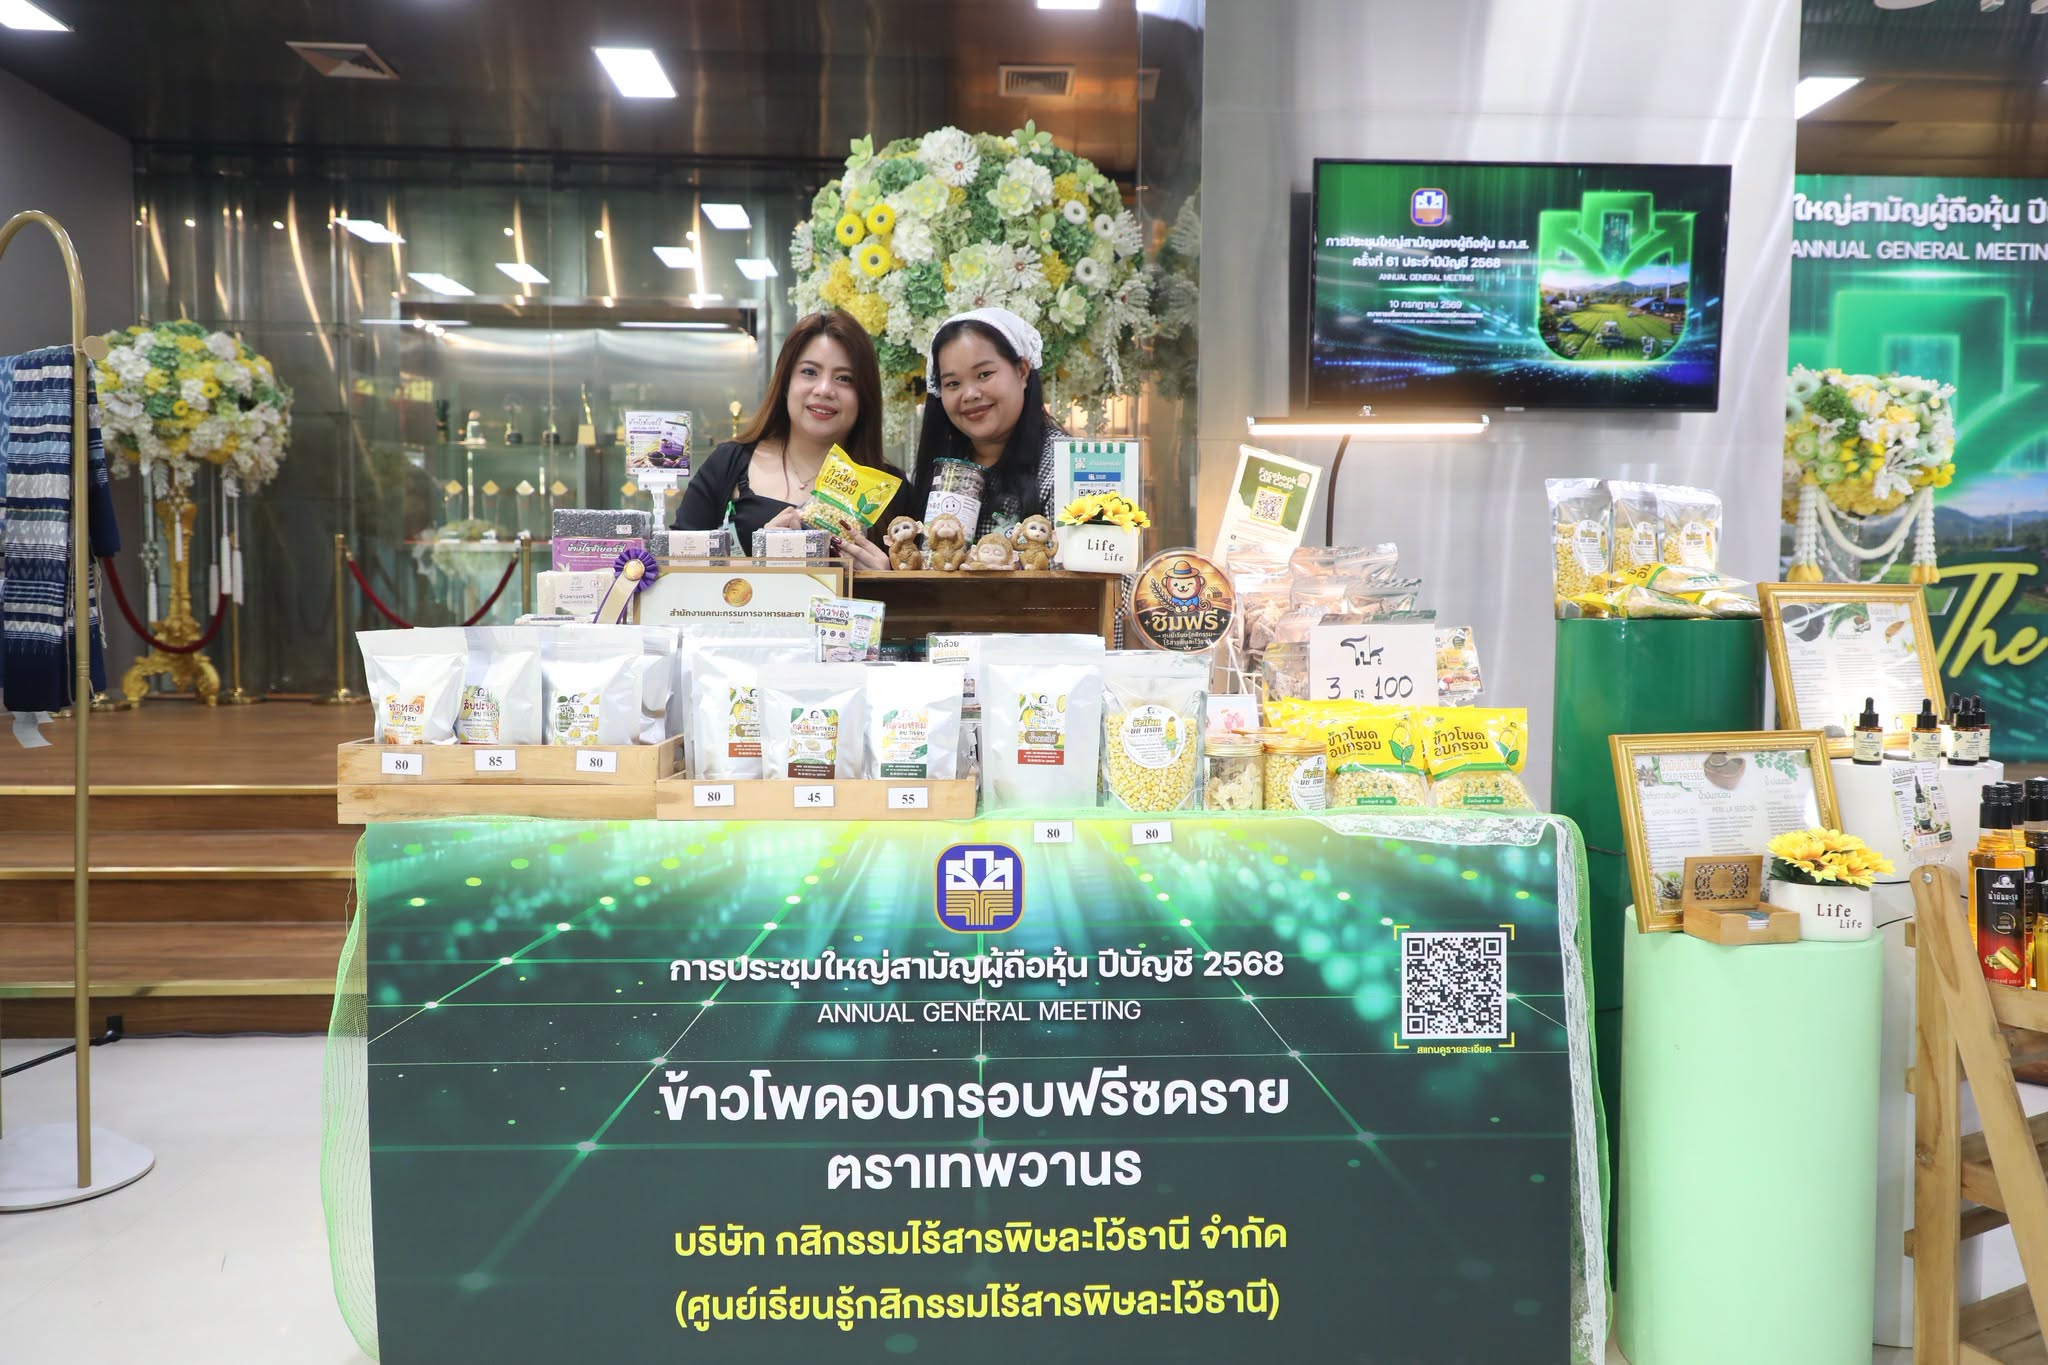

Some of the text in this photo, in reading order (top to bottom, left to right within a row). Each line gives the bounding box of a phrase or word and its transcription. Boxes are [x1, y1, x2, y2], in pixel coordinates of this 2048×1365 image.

[1326, 235, 1529, 252] การประชุมใหญ่สามัญของผู้ถือหุ้น ธ.ก.ส.
[1791, 240, 2048, 261] ANNUAL GENERAL MEETIN
[1352, 252, 1501, 269] ครั้งที่ 61 ประจำปีบัญชี 2568
[1379, 273, 1474, 282] ANNUAL GENERAL MEETING
[1389, 301, 1399, 309] 10
[1401, 301, 1438, 310] กรกฎาคม
[1258, 467, 1298, 484] Facebook
[1273, 478, 1294, 490] Code
[1087, 539, 1116, 551] Life
[1104, 552, 1124, 562] Life
[669, 608, 805, 619] สำนักงานคณะกรรมการอาหารและยา
[1151, 609, 1219, 632] ชิมฟรี
[1938, 562, 2048, 678] The
[1340, 634, 1384, 666] โปร
[1326, 677, 1341, 700] 3
[1374, 675, 1413, 700] 100
[1328, 726, 1378, 747] ข้าวโพด
[1433, 726, 1486, 745] ข้าวโพด
[1329, 741, 1382, 758] อบกรอบ
[1434, 741, 1489, 758] อบกรอบ
[395, 760, 408, 770] 80
[489, 756, 502, 767] 85
[590, 757, 603, 768] 80
[708, 791, 721, 802] 80
[808, 792, 821, 803] 45
[902, 794, 915, 805] 55
[1047, 827, 1060, 839] 80
[1145, 828, 1159, 840] 80
[1817, 903, 1851, 917] Life
[1839, 919, 1863, 928] Life
[670, 947, 1284, 989] การประชุมใหญ่สามัญผู้ถือหุ้น ปีบัญชี 2568
[817, 1000, 1141, 1023] ANNUAL GENERAL MEETING
[1417, 1044, 1492, 1056] สแกนดูรายละเอียด
[658, 1065, 1289, 1121] ข้าวโพดอบกรอบฟรีซดราย
[827, 1150, 1142, 1190] ตราเทพวานร
[675, 1214, 1287, 1257] บริษัท กสิกรรมไร้สารพิษละโว้ธานี จำกัด
[675, 1278, 1280, 1332] (ศูนย์เรียนรู้กสิกรรมไร้สารพิษละโว้ธานี)
